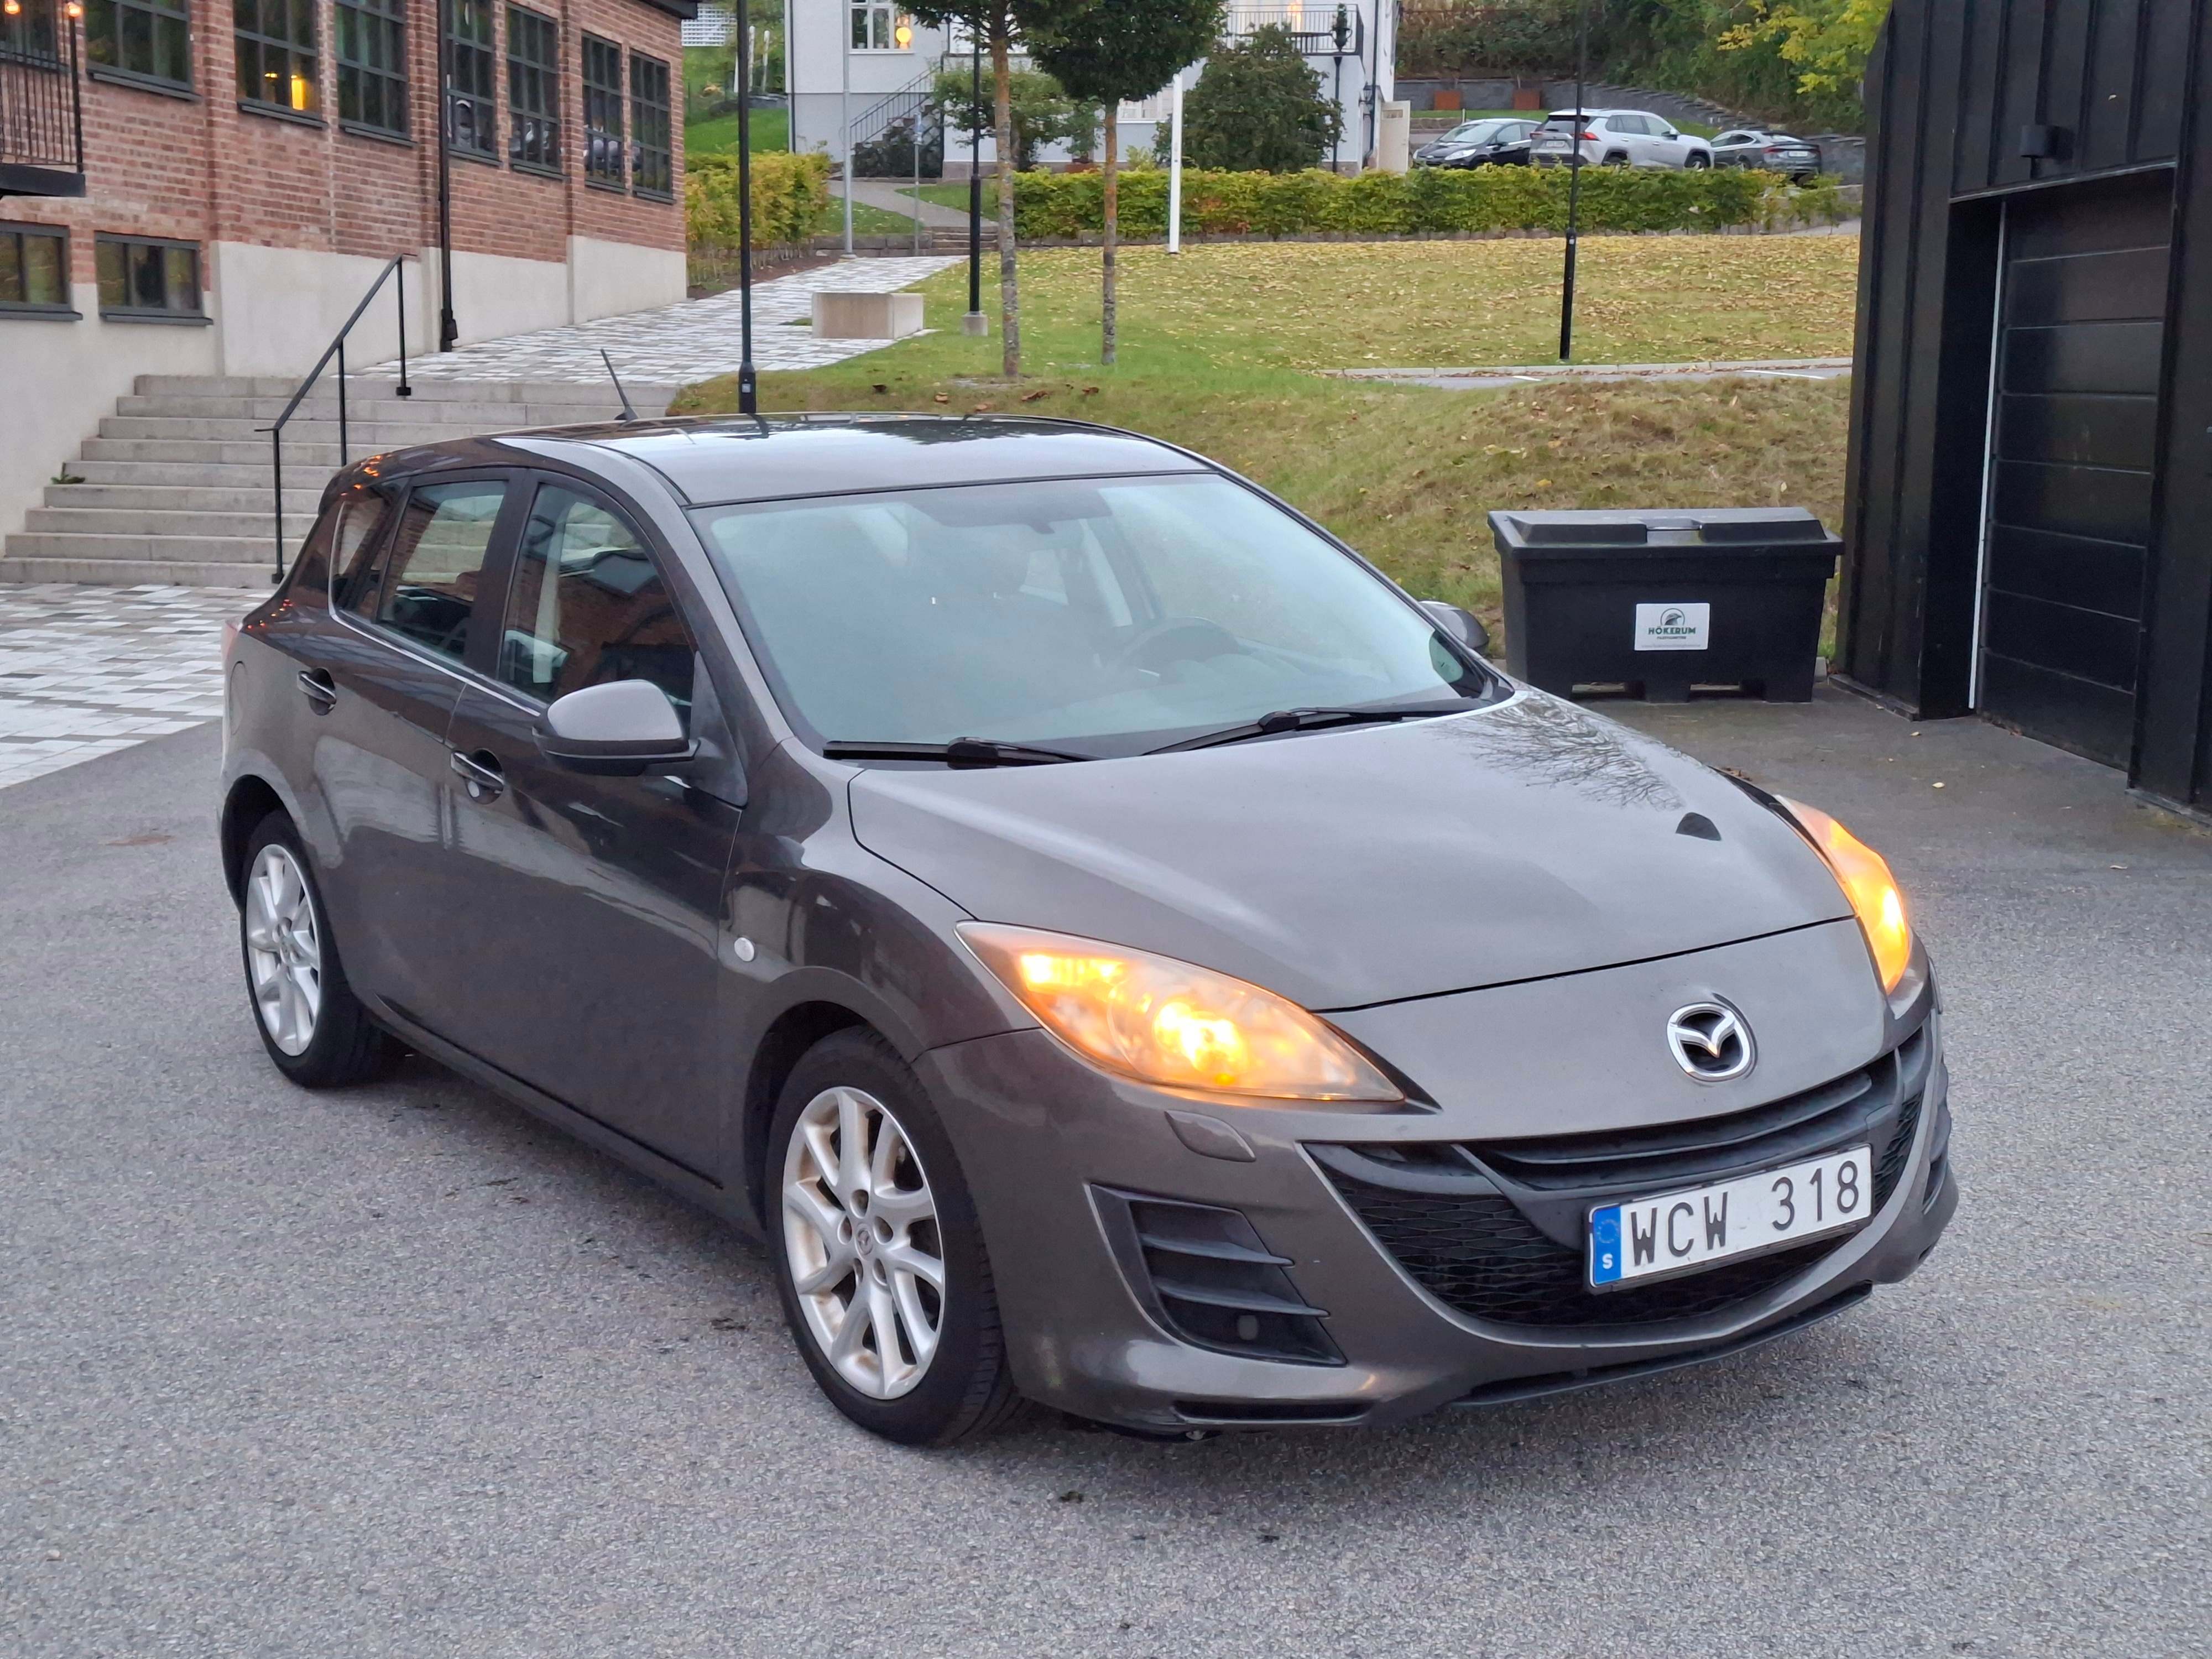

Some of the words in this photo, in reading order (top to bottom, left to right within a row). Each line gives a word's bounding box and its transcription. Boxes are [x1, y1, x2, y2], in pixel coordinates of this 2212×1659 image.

[1630, 1191, 1728, 1266] WCW
[1771, 1160, 1859, 1231] 318
[1602, 1254, 1613, 1269] S
